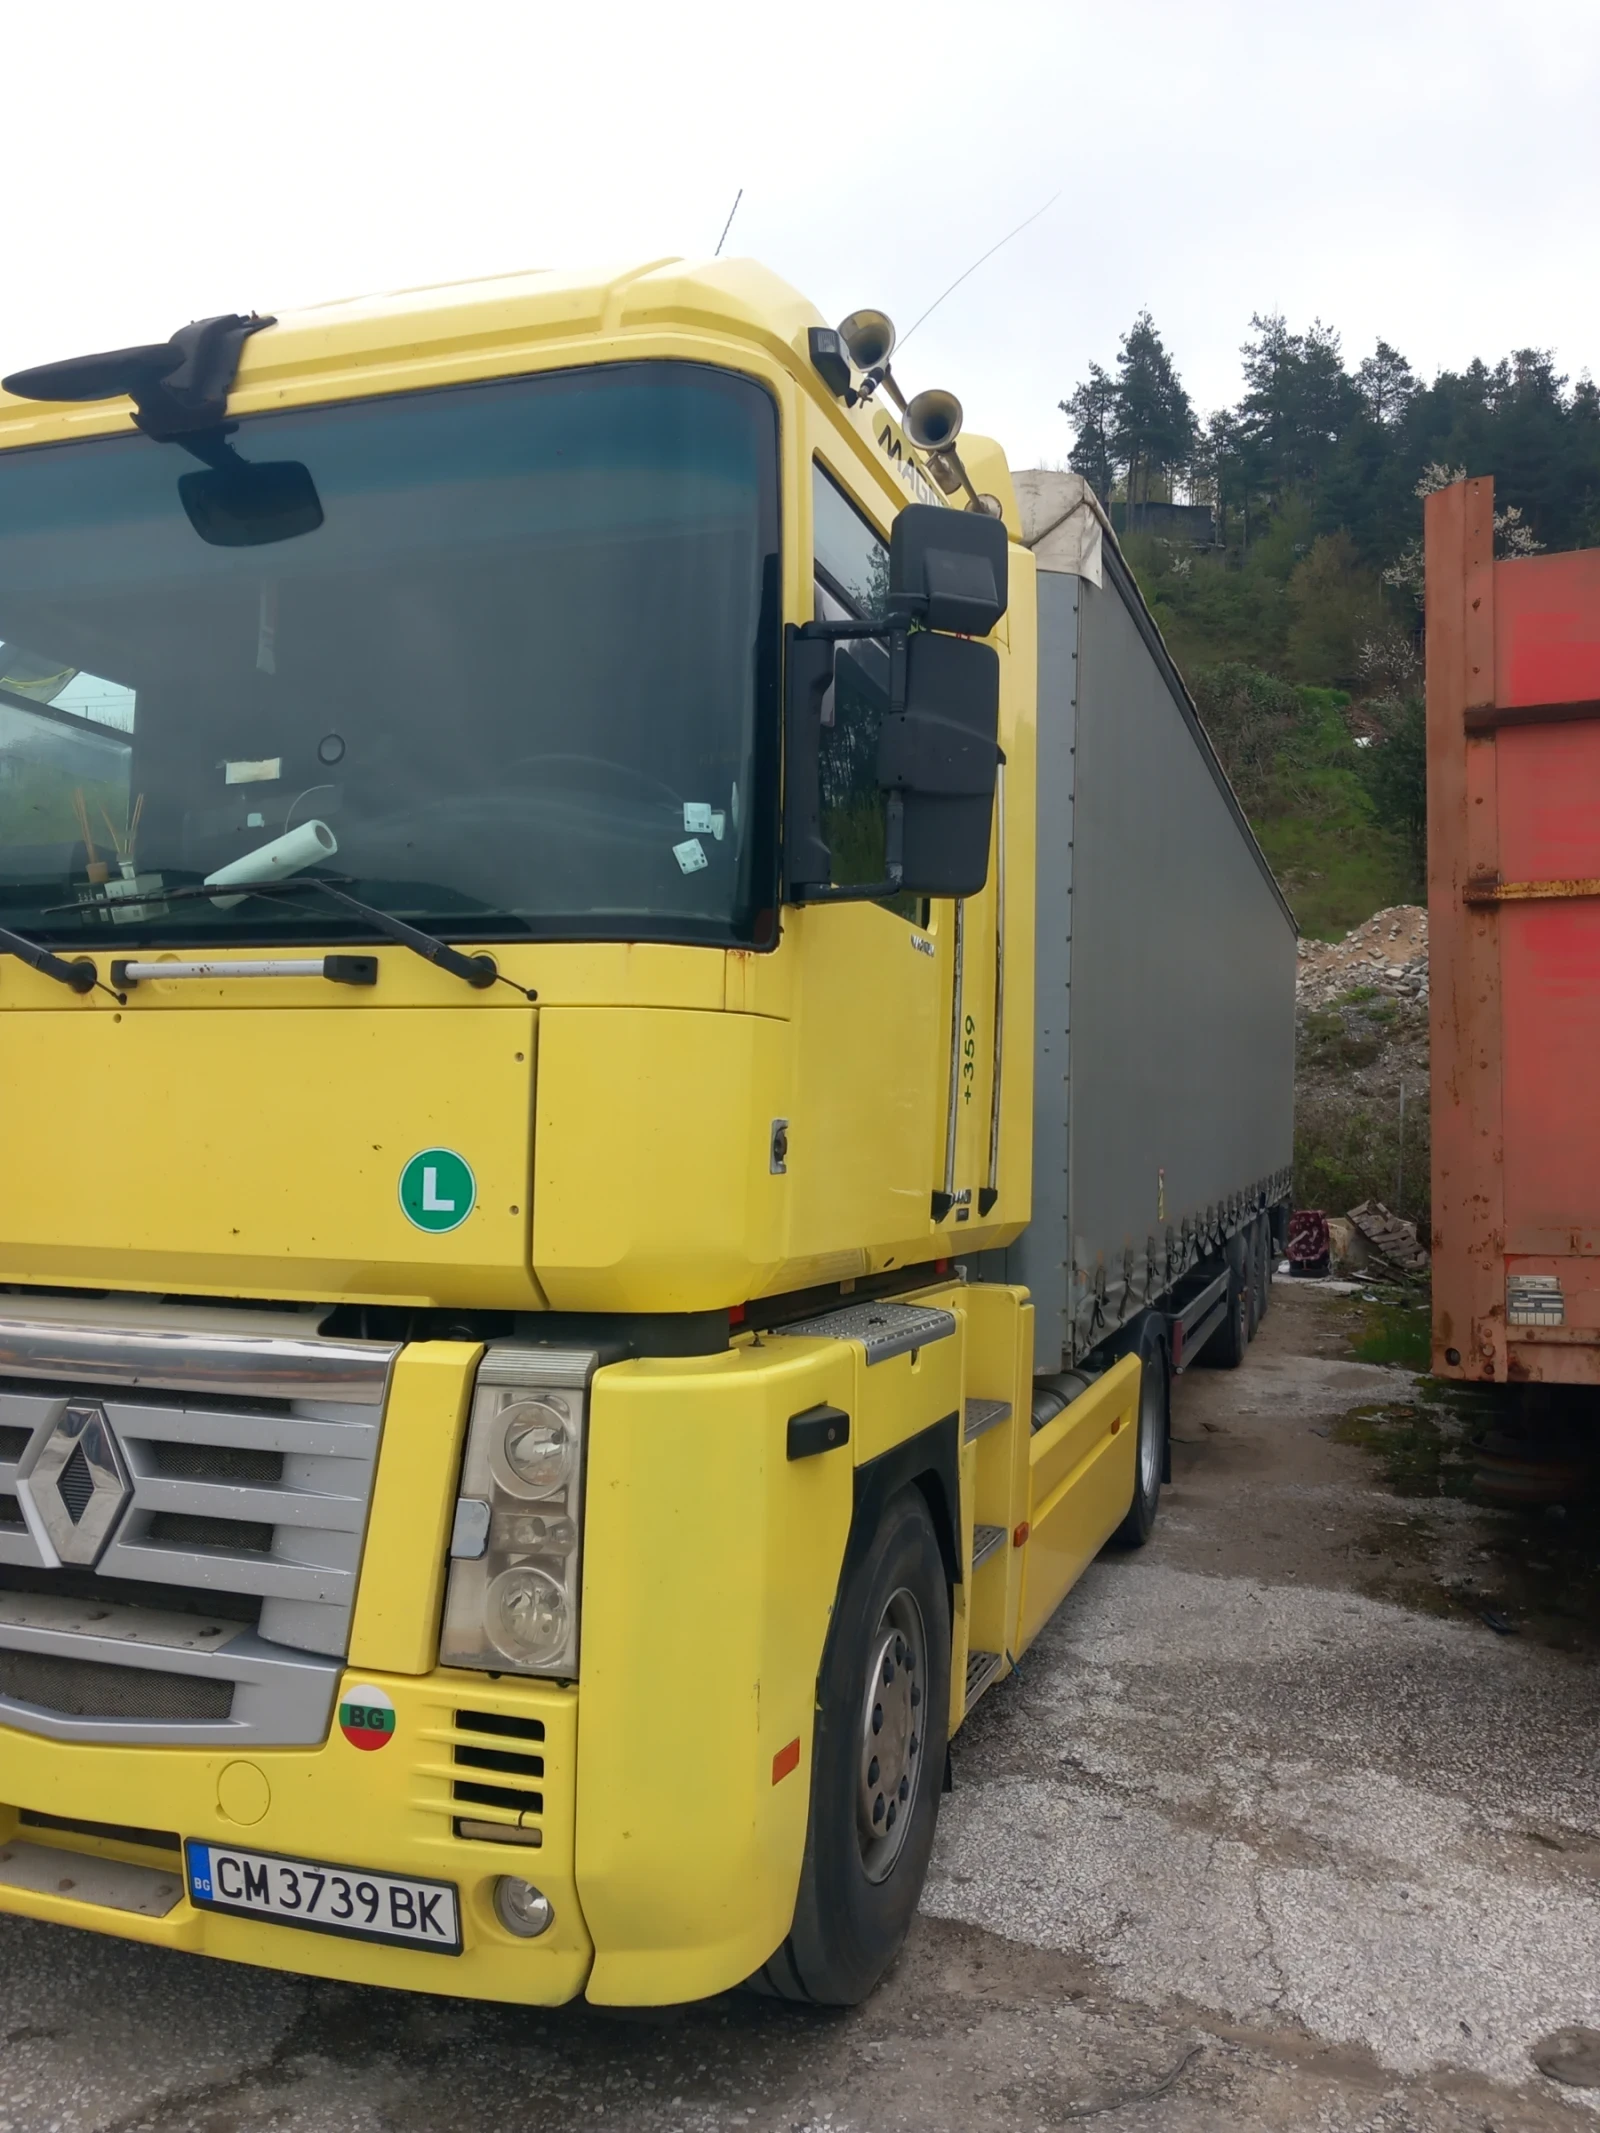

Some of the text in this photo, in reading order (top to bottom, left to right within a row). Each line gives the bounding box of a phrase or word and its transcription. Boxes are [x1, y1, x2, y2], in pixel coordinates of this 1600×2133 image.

[963, 1015, 975, 1105] +359
[423, 1167, 455, 1211] L
[349, 1705, 385, 1730] BG
[194, 1877, 211, 1891] BG
[279, 1868, 379, 1923] 3739
[389, 1886, 446, 1936] BK
